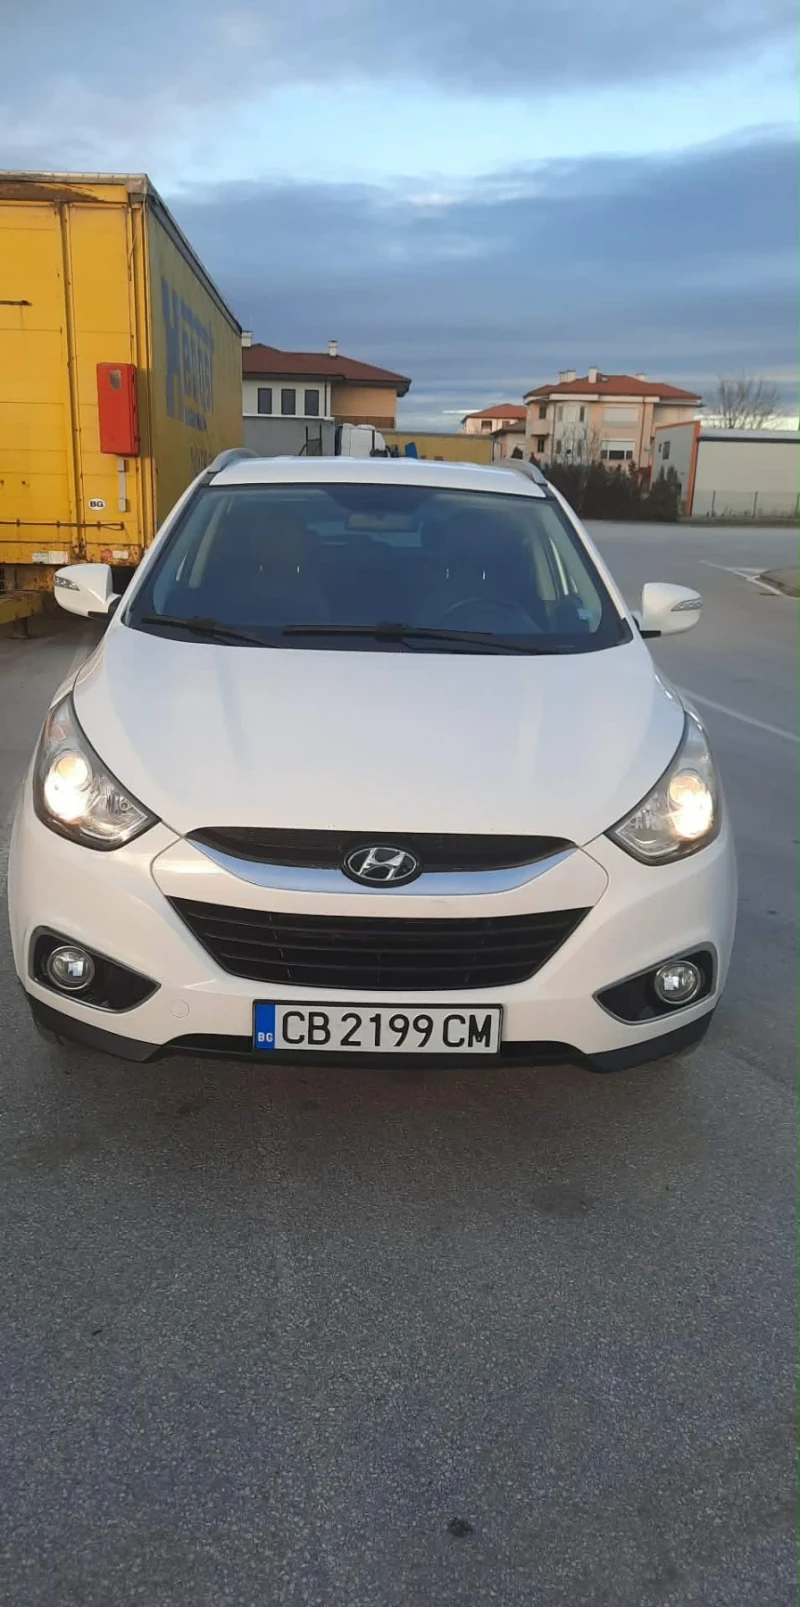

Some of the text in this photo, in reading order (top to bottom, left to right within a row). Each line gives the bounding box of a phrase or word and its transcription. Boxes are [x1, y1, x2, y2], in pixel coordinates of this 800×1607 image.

[90, 500, 104, 508] BG
[282, 1010, 492, 1048] CB 2199 CM
[257, 1032, 274, 1042] BG
